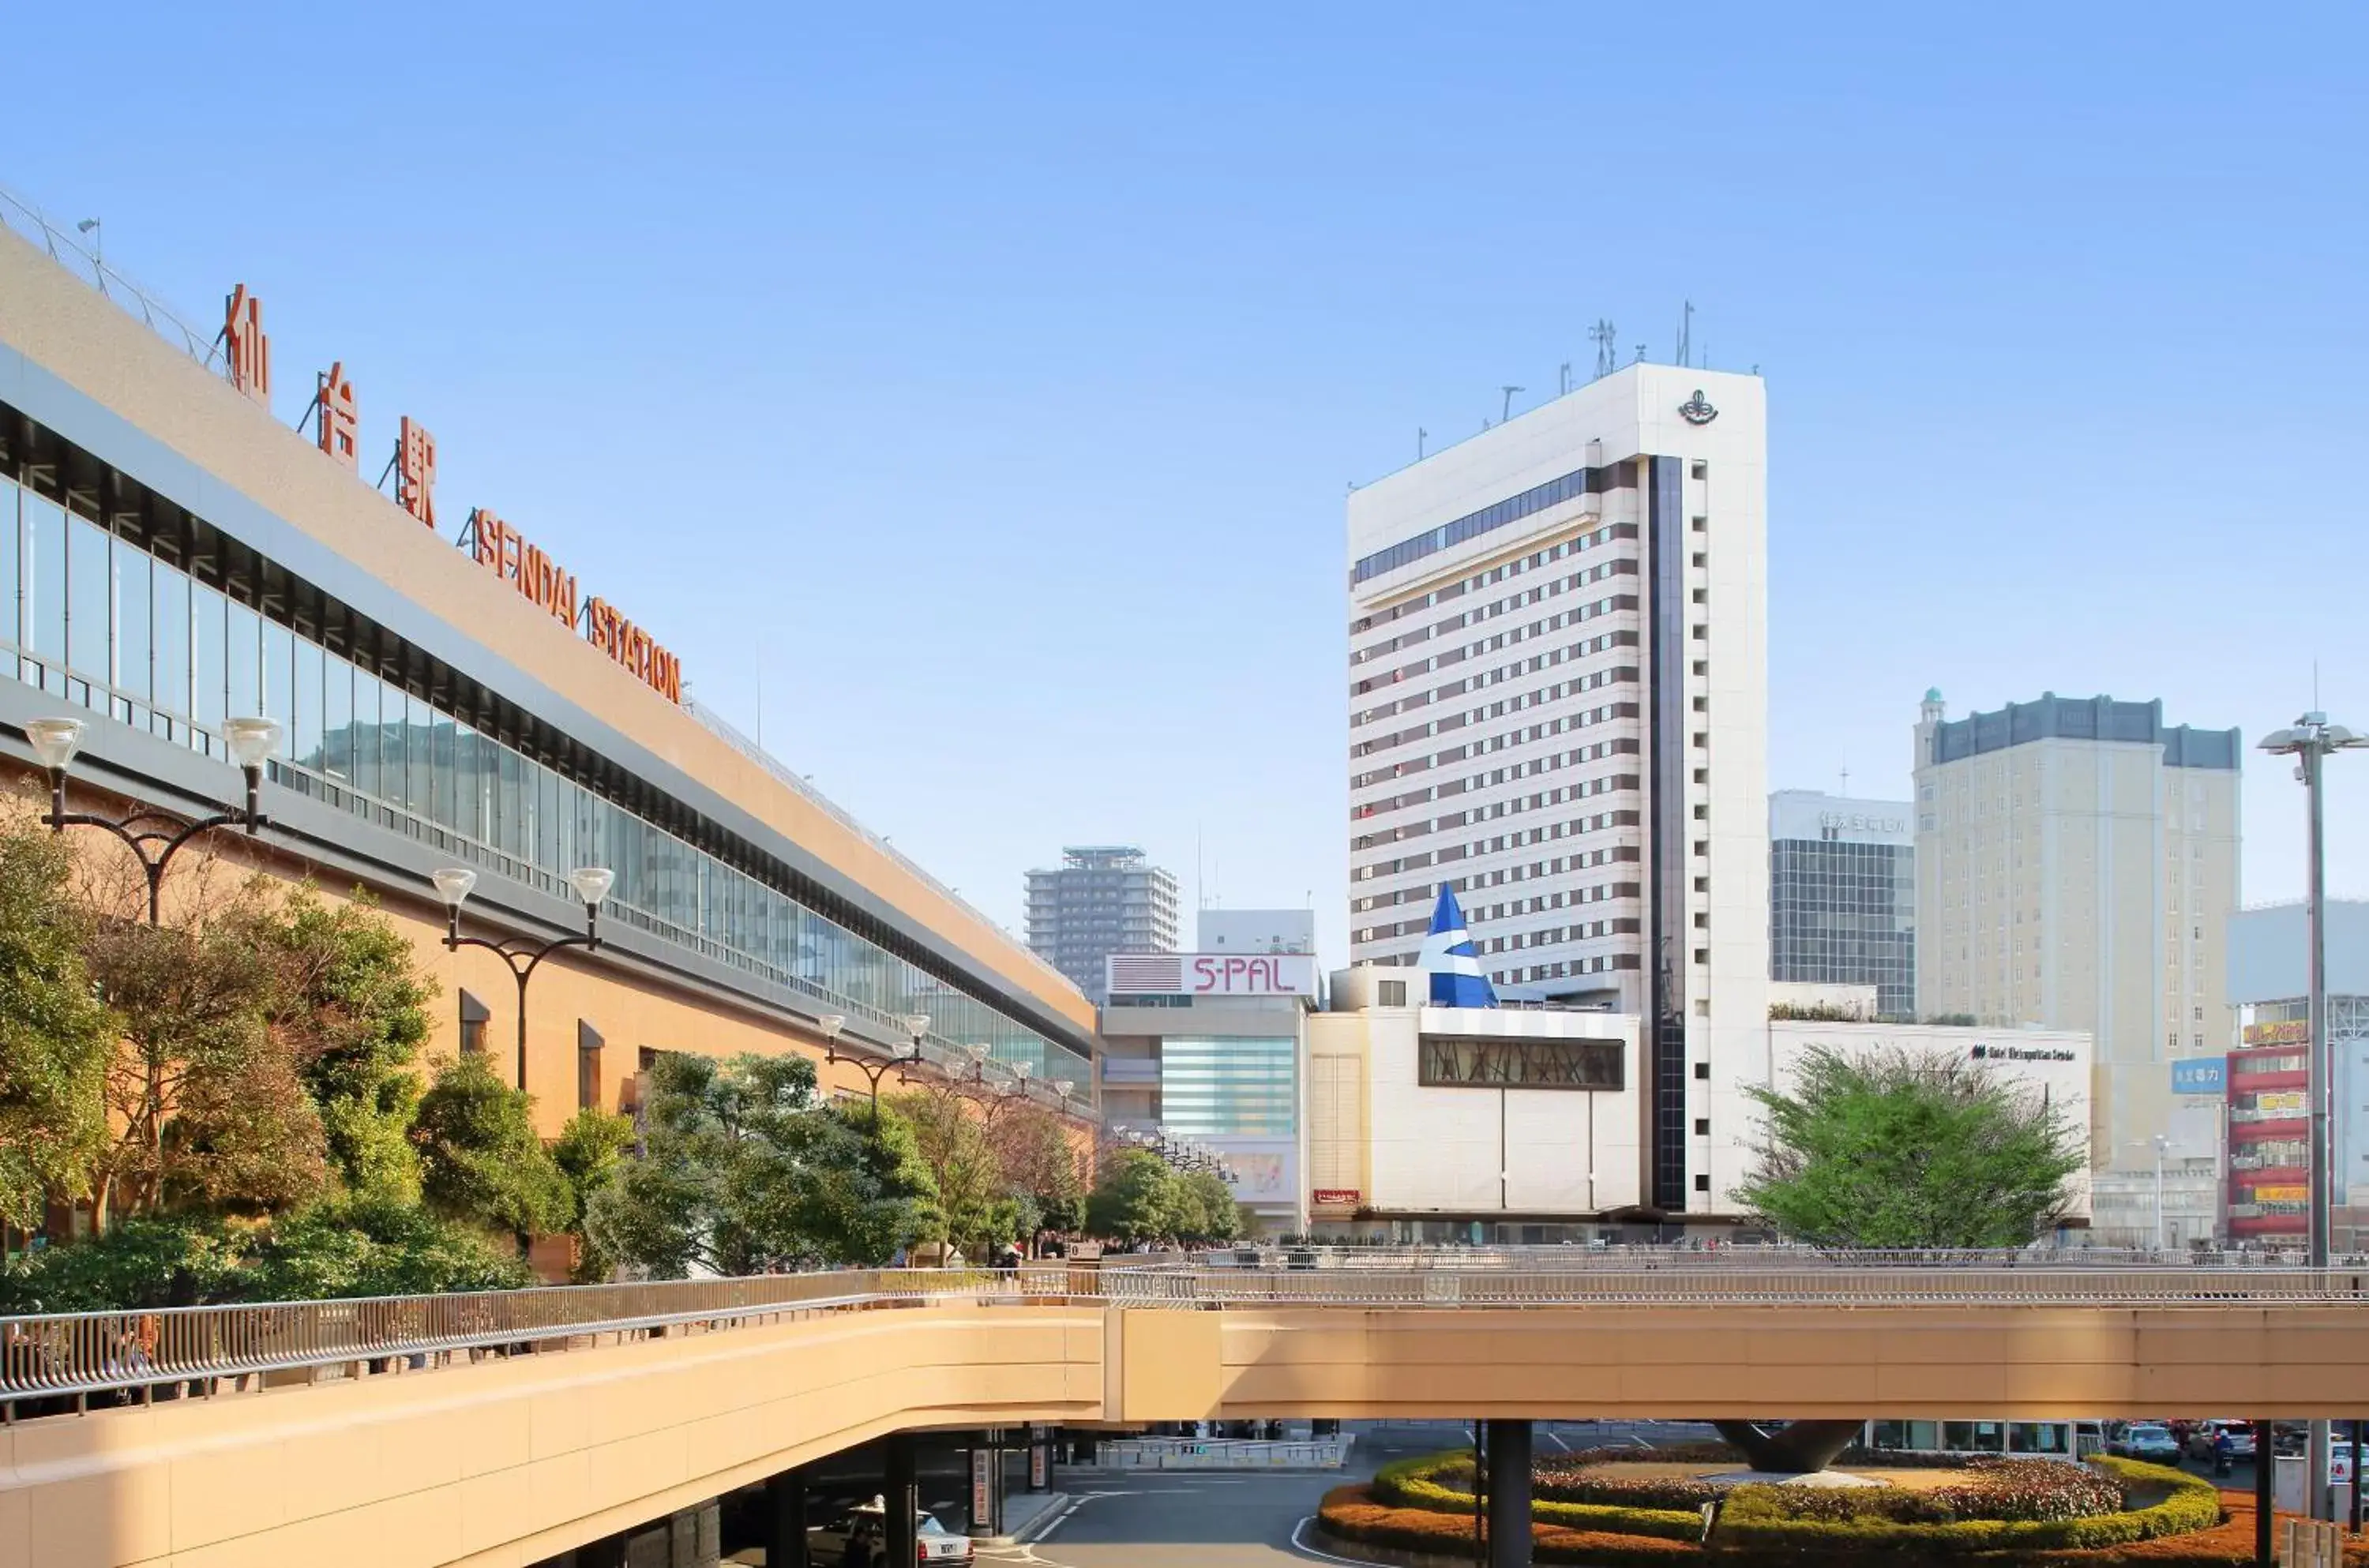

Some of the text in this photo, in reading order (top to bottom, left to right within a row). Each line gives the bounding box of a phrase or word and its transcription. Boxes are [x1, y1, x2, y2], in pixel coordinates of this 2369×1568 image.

[226, 283, 436, 529] 仙台駅
[476, 508, 680, 704] SENDAI STATION
[1195, 958, 1295, 992] S-PAL
